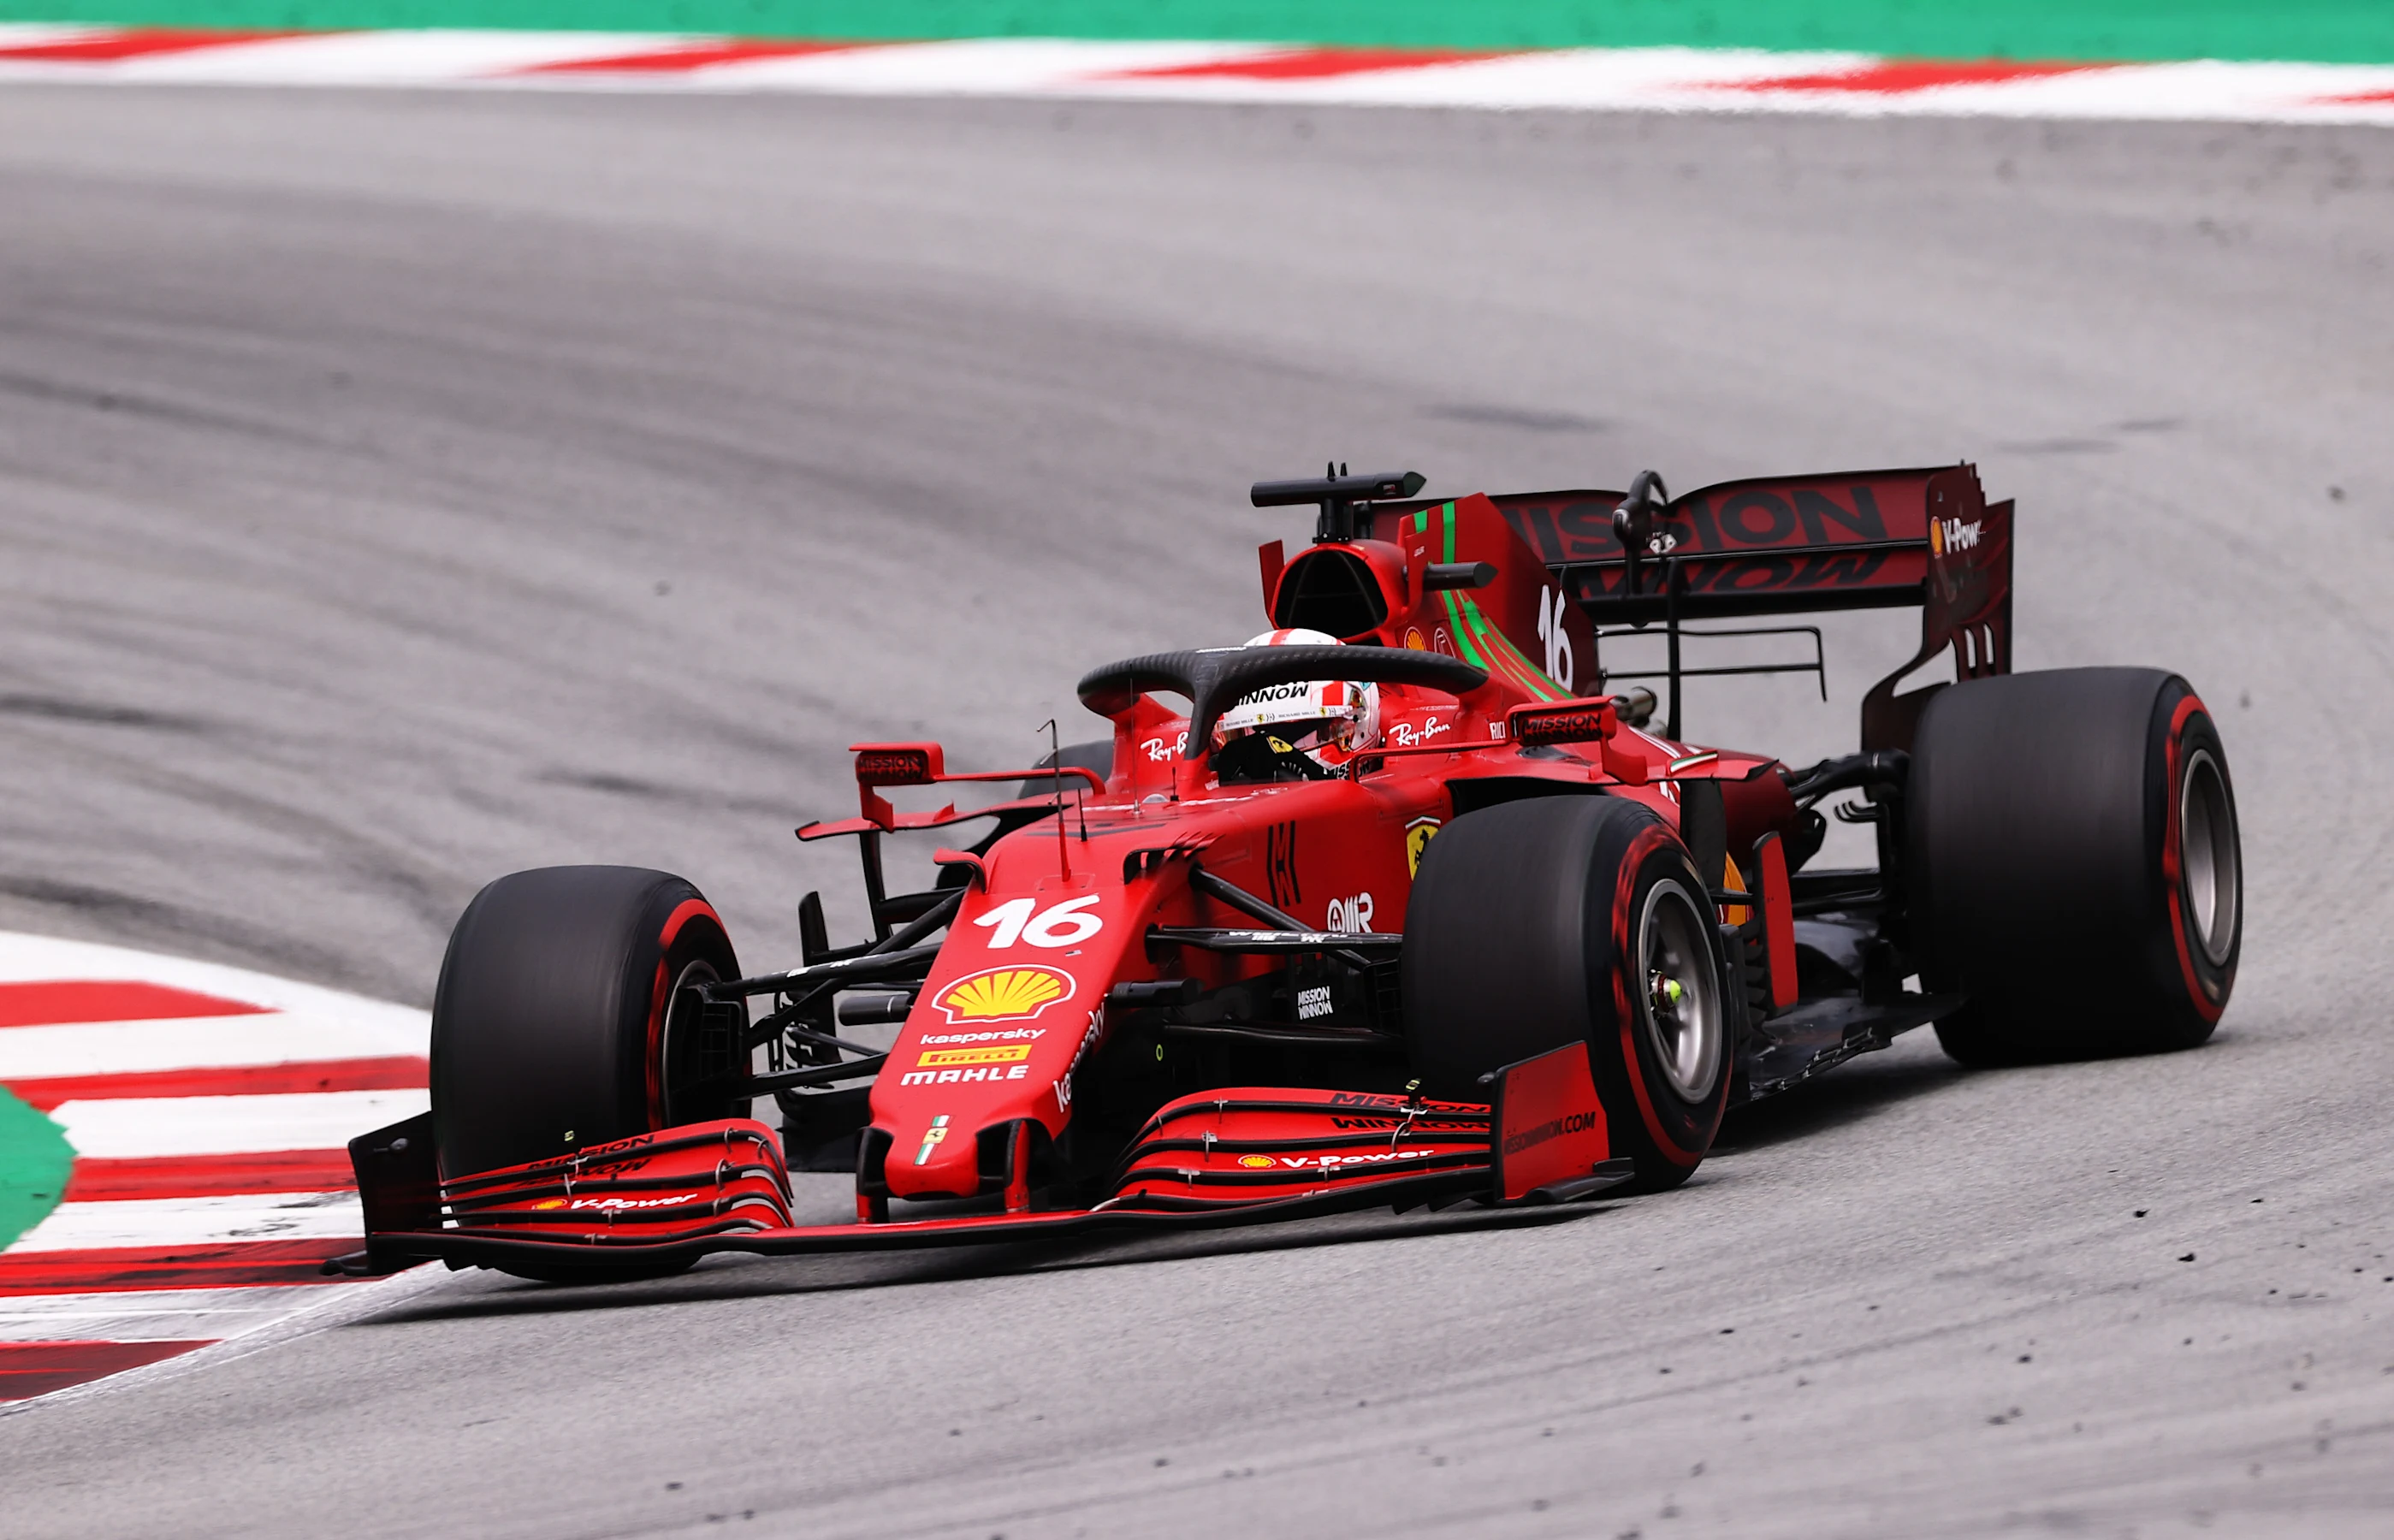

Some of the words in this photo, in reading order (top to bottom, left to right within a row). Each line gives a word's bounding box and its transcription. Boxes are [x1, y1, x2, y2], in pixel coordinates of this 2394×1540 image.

[1538, 585, 1573, 693] 16
[1389, 717, 1450, 746] Ray-Ban
[1525, 714, 1601, 731] MISSION
[973, 893, 1103, 948] 16
[1297, 986, 1330, 1006] MISSION
[1298, 1000, 1333, 1020] WINNOW
[920, 1028, 1046, 1045] kaspersky
[900, 1064, 1029, 1086] MAHLE
[1330, 1093, 1488, 1112] MISON
[1280, 1149, 1435, 1168] V-Power
[571, 1194, 698, 1209] V-Power
